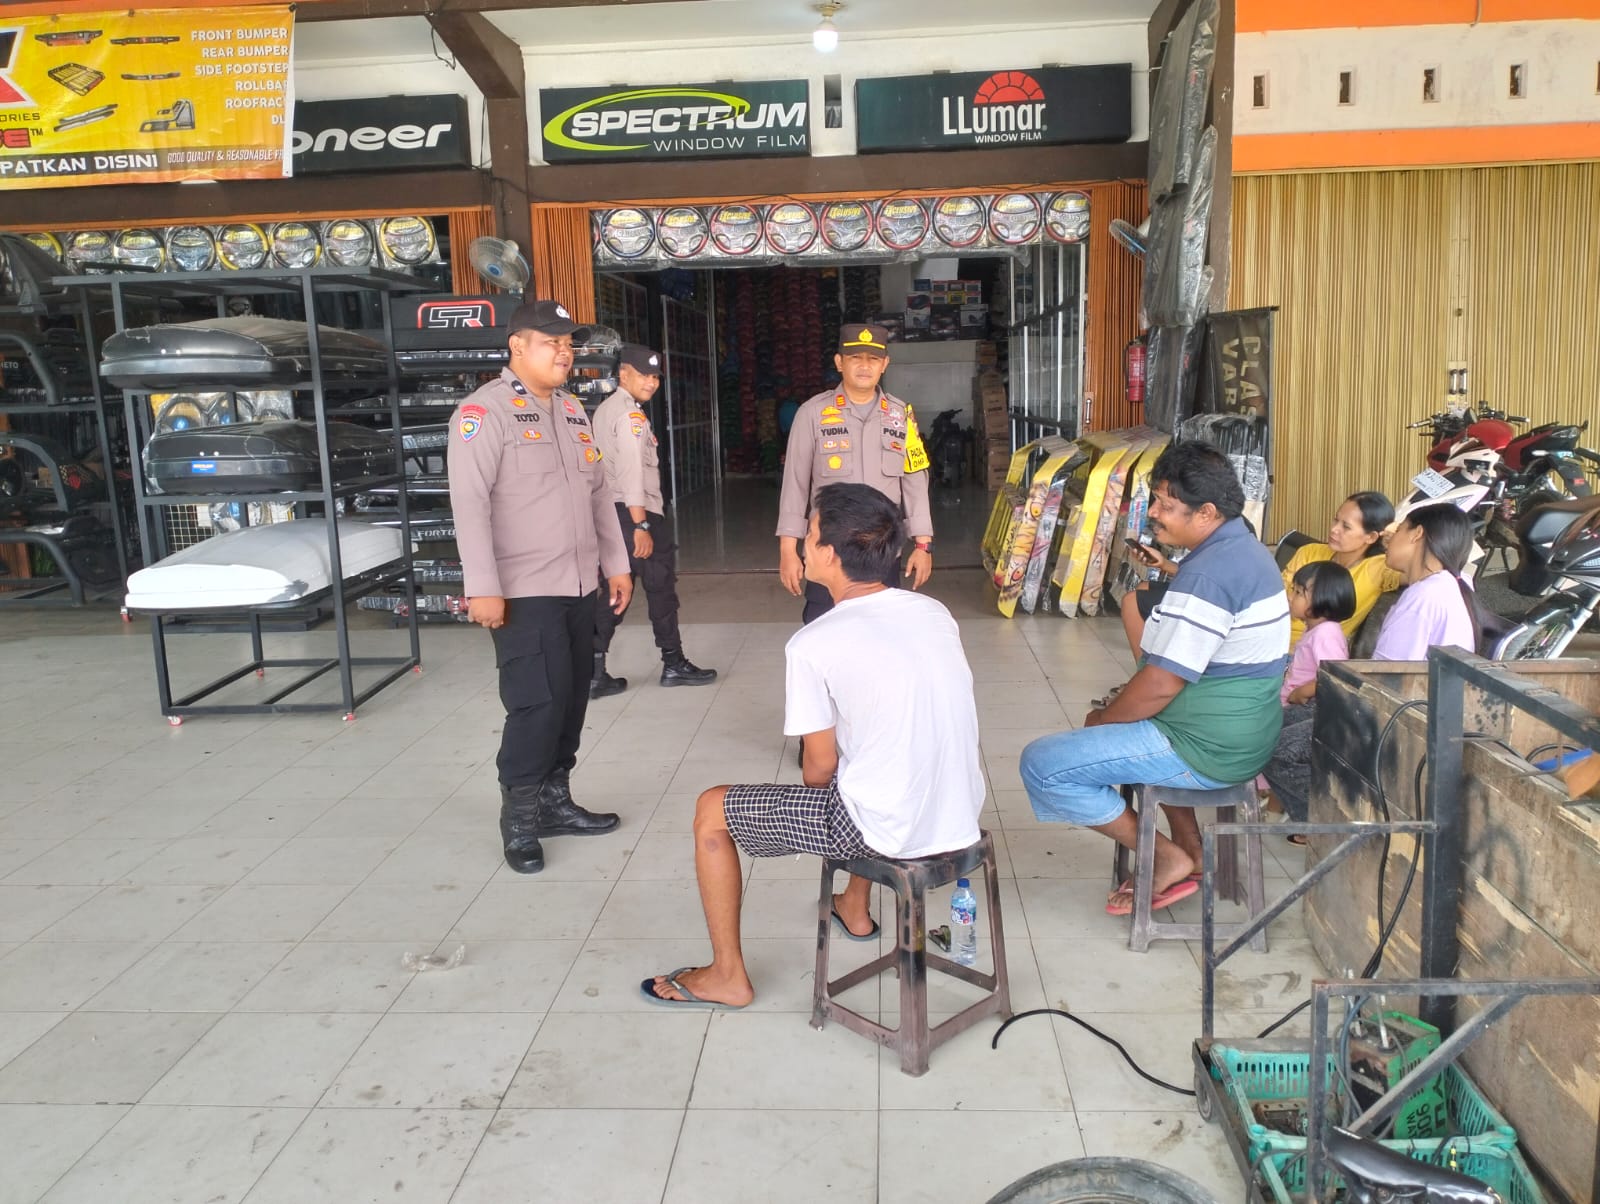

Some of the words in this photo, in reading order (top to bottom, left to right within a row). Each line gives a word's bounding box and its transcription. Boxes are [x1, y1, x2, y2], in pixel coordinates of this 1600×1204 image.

[191, 29, 233, 41] FRONT
[236, 27, 289, 39] BUMPER
[202, 46, 234, 58] REAR
[238, 45, 289, 56] BUMPER
[195, 64, 223, 75] SIDE
[571, 102, 807, 137] SPECTRUM
[943, 95, 1047, 135] LLumar
[653, 137, 745, 151] WINDOW
[757, 134, 806, 148] FILM
[975, 133, 1018, 143] WINDOW
[1020, 132, 1042, 141] FILM
[94, 154, 158, 170] DISINI
[167, 152, 185, 163] GOOD
[187, 151, 215, 162] QUALITY
[216, 150, 224, 161] &
[226, 149, 273, 161] REASONABLE
[820, 427, 849, 437] YUDHA
